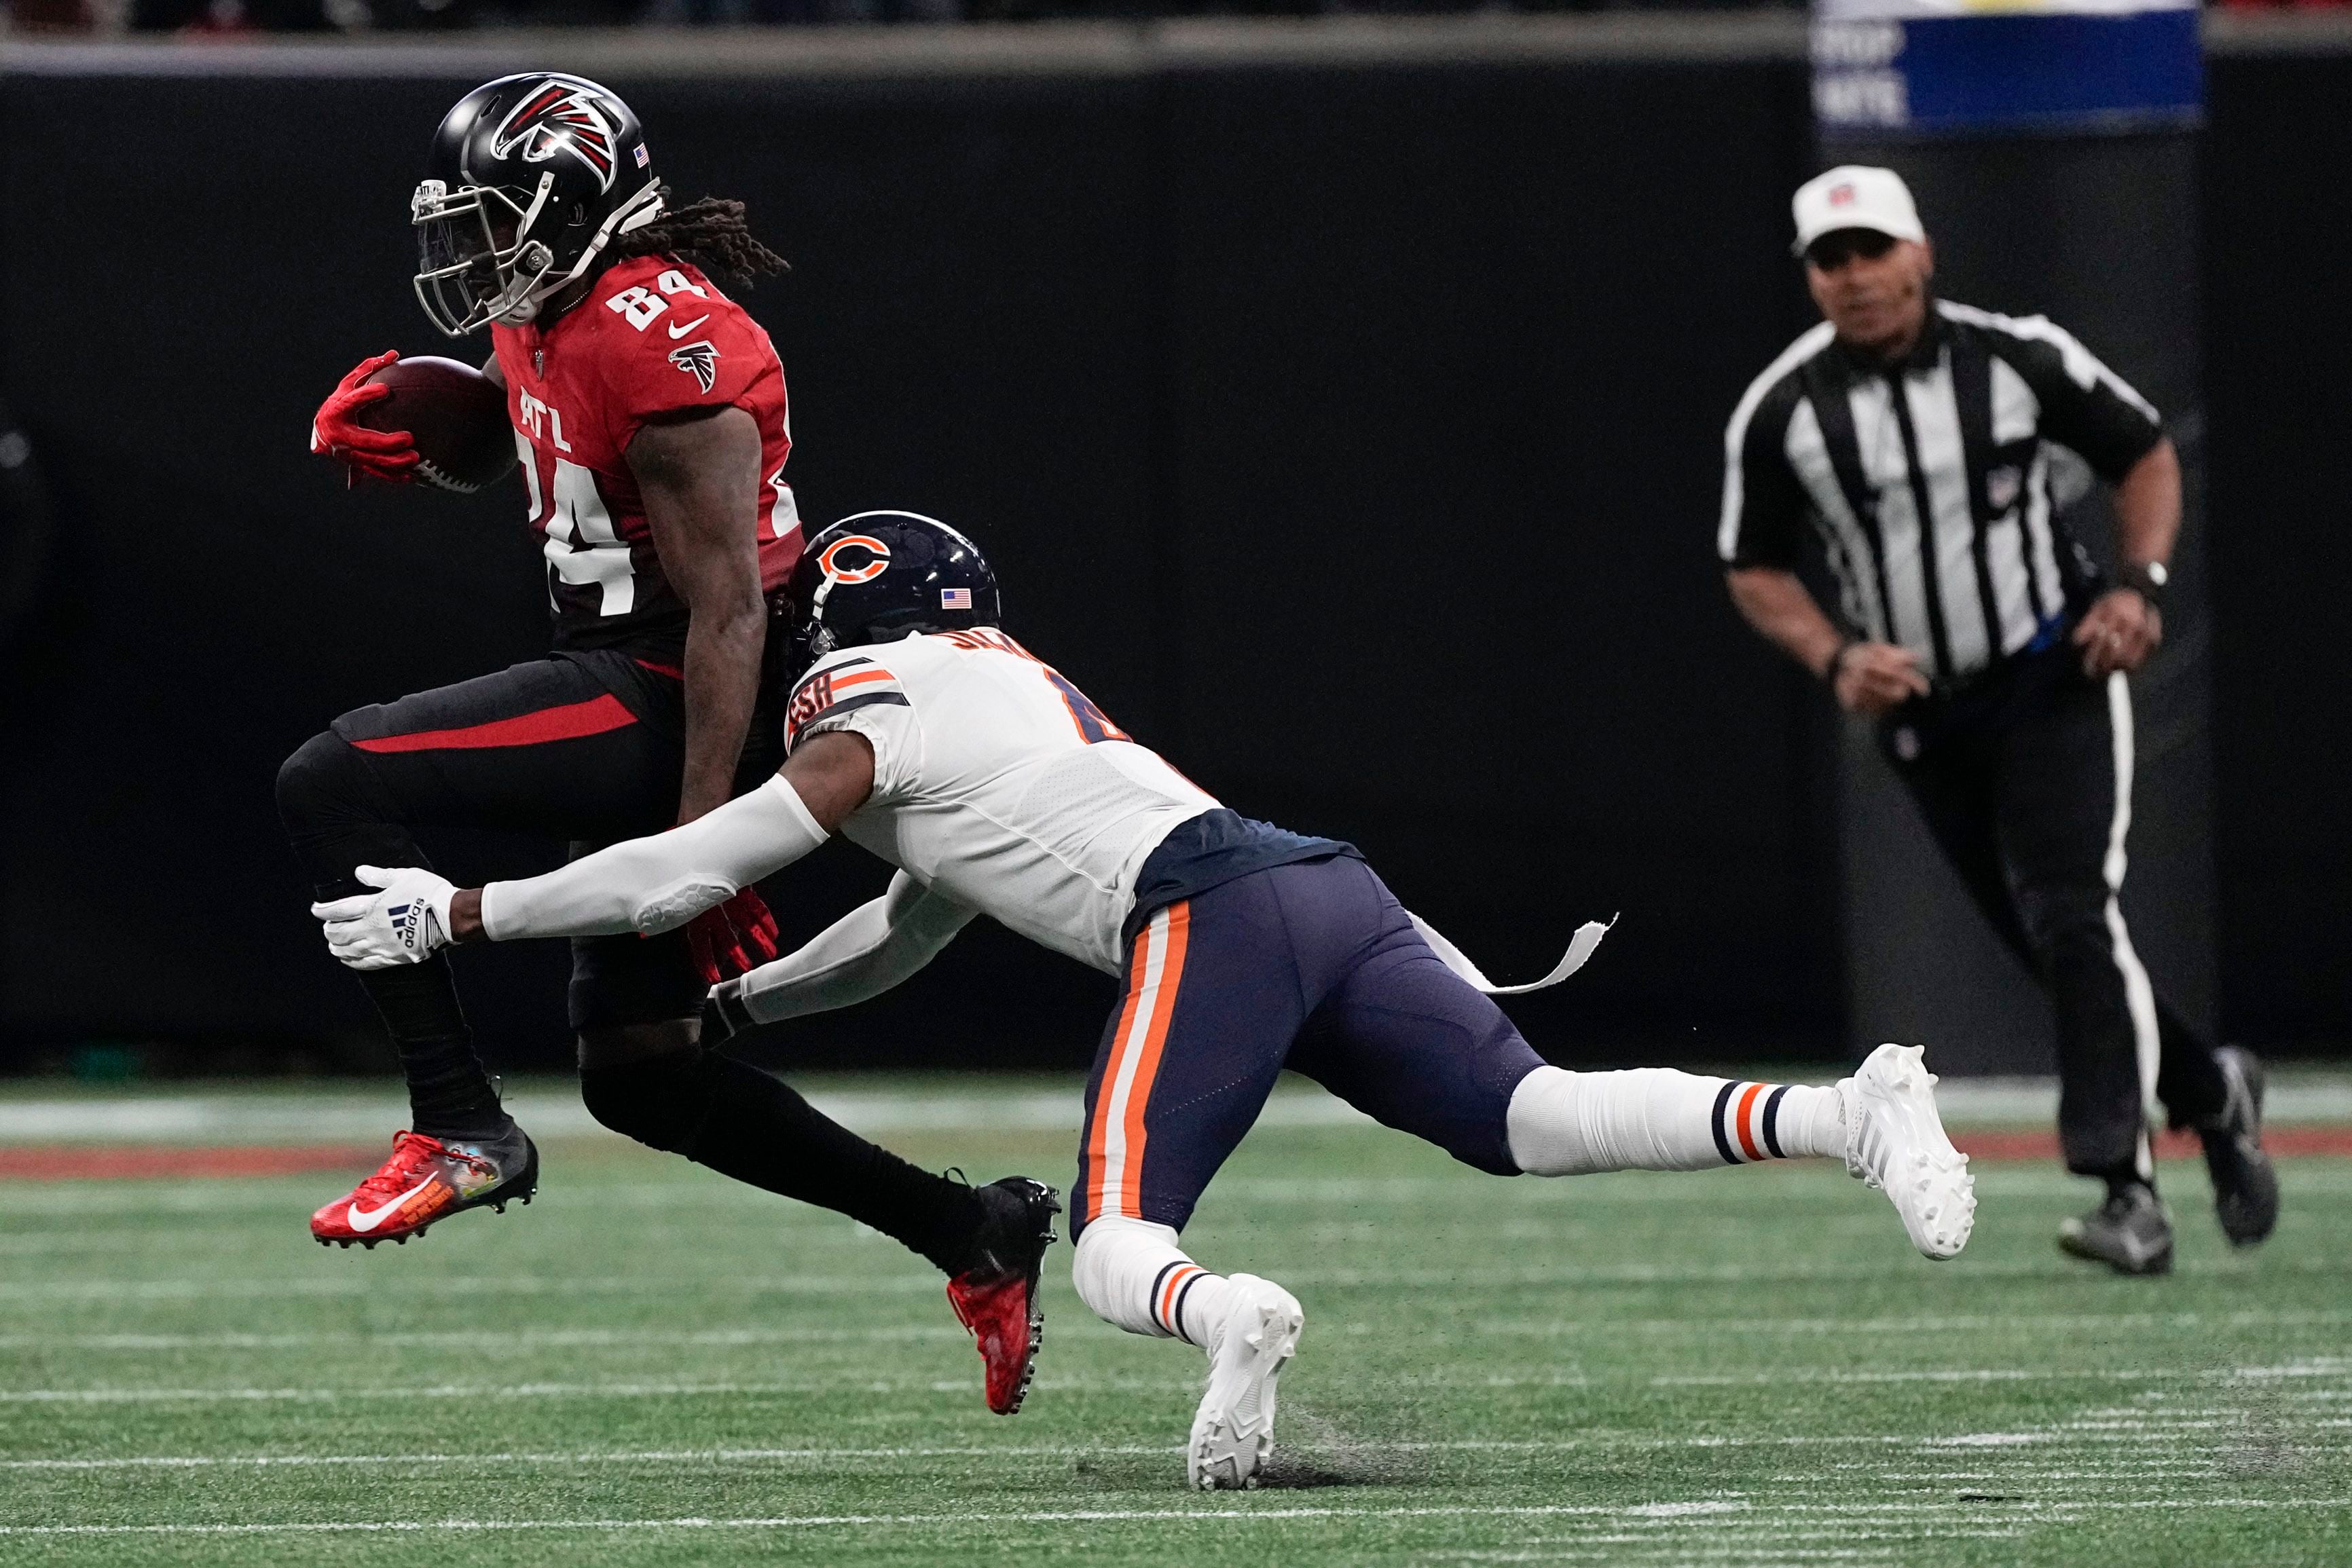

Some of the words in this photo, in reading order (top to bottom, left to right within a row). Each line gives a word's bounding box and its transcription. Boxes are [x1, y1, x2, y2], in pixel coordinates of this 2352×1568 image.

[605, 270, 710, 332] 84
[520, 385, 572, 453] ATL
[815, 534, 891, 584] C
[404, 897, 424, 948] adidas
